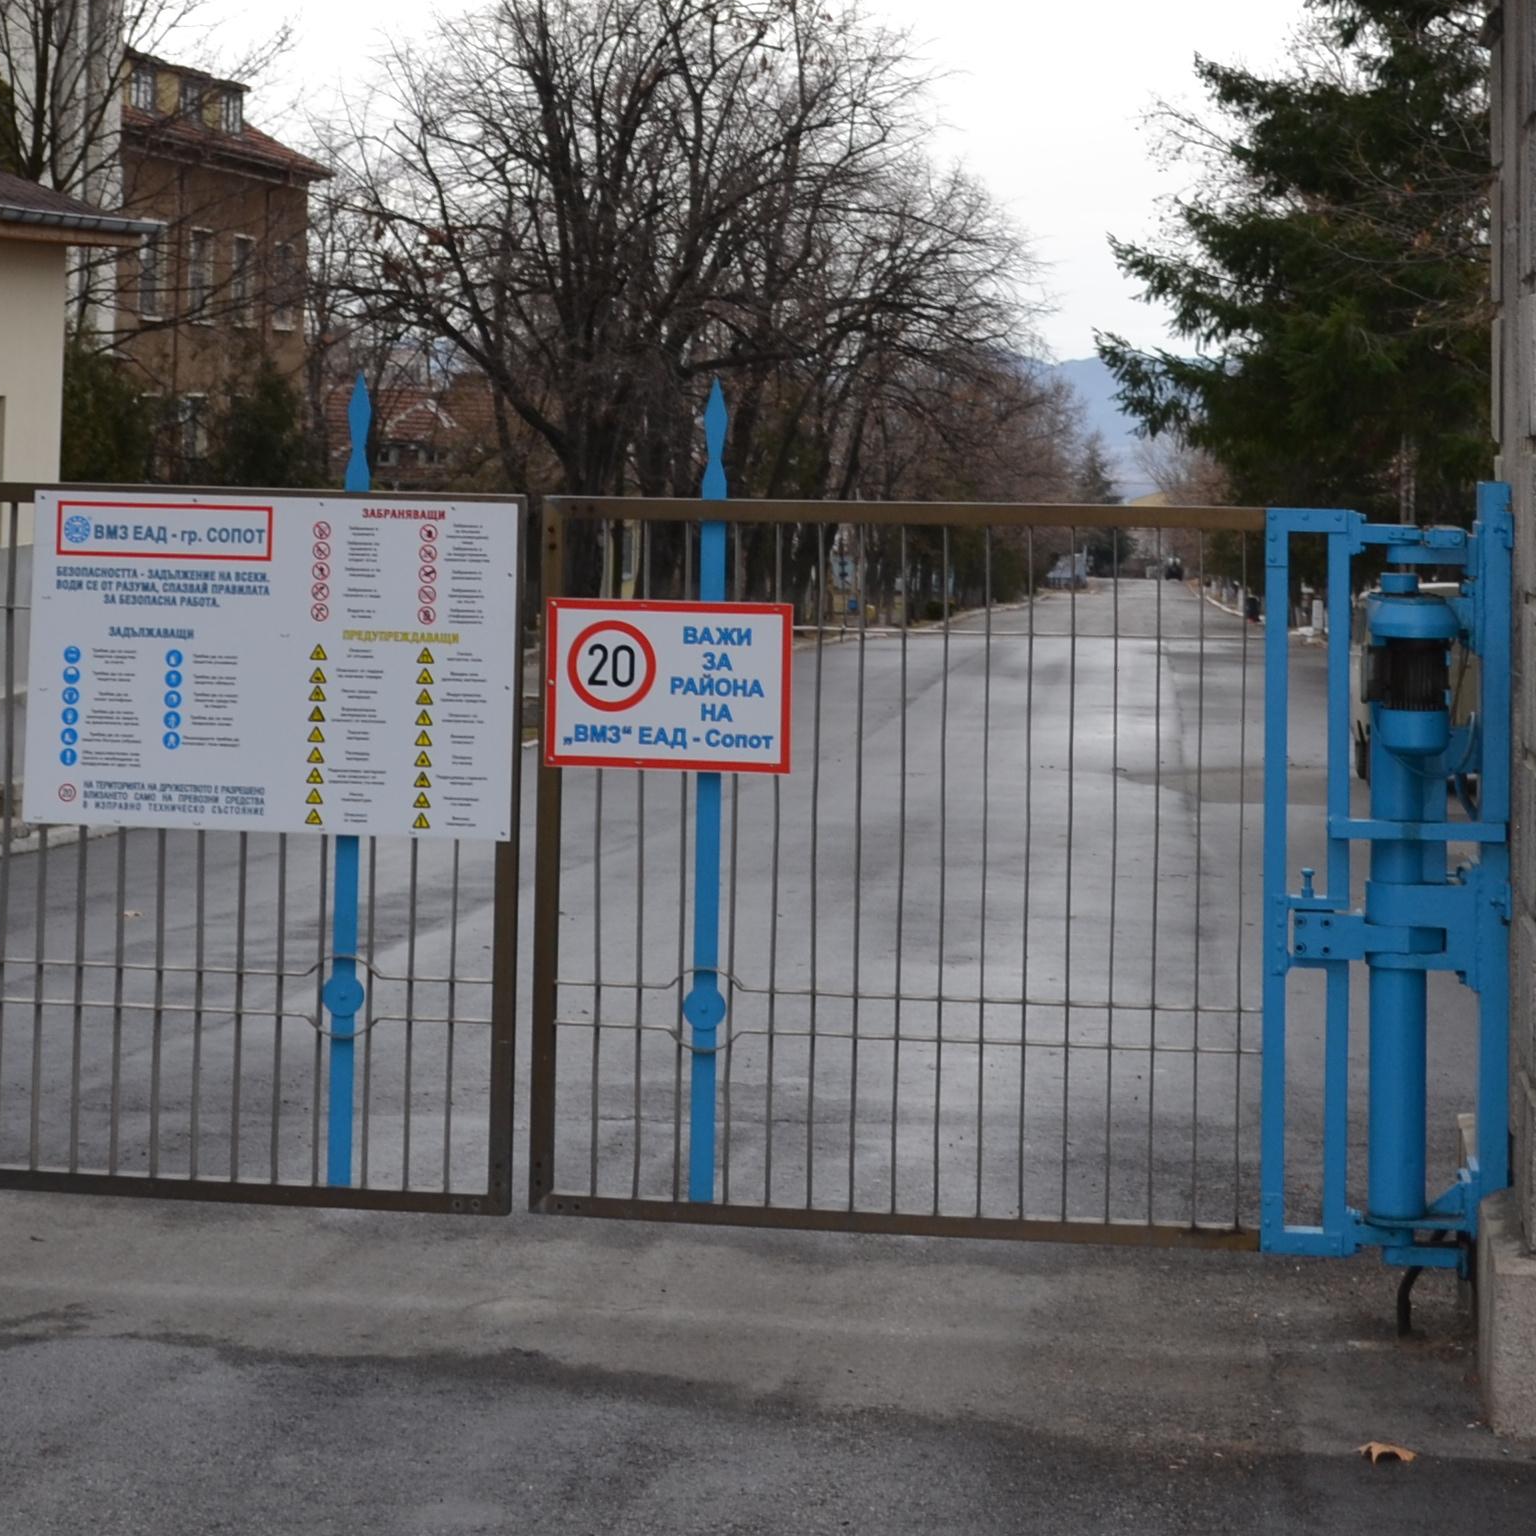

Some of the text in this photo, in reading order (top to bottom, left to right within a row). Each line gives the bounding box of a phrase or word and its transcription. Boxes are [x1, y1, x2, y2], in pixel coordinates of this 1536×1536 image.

[362, 508, 446, 521] ЗАБРАНЯВАЩИ
[94, 524, 128, 540] ВМЗ
[133, 525, 167, 544] ЕАД
[181, 530, 202, 545] гр.
[207, 528, 265, 544] СОПОТ
[56, 566, 138, 579] БЕЗОПАСНОСТТА
[147, 568, 216, 582] ЗАДЪЛЖЕНИЕ
[219, 571, 231, 582] НА
[56, 579, 270, 596] ВОДИ СЕ ОТ РАЗУМА, СПАЗВАЙ ПРАВИЛАТА
[104, 594, 220, 608] ЗА БЕЗОПАСНА РАБОТА.
[108, 626, 194, 640] ЗАДЪЛЖАВАЩИ
[342, 629, 460, 644] ПРЕДУПРЕЖДАВАЩИ
[682, 626, 752, 646] ВАЖИ
[587, 643, 635, 688] 20
[702, 652, 733, 671] ЗА
[670, 674, 764, 698] РАЙОНА
[700, 704, 733, 722] НА
[638, 727, 688, 749] ЕАД
[705, 729, 774, 749] Сопот
[83, 781, 94, 789] НА
[147, 783, 157, 791] НА
[214, 785, 219, 794] Е
[134, 792, 156, 802] САМО
[162, 793, 173, 802] НА
[225, 795, 264, 806] СРЕДСТВА
[82, 800, 264, 816] В ИЗПРАВНО ТЕХНИЧЕСКО СЪСТОЯНИЕ
